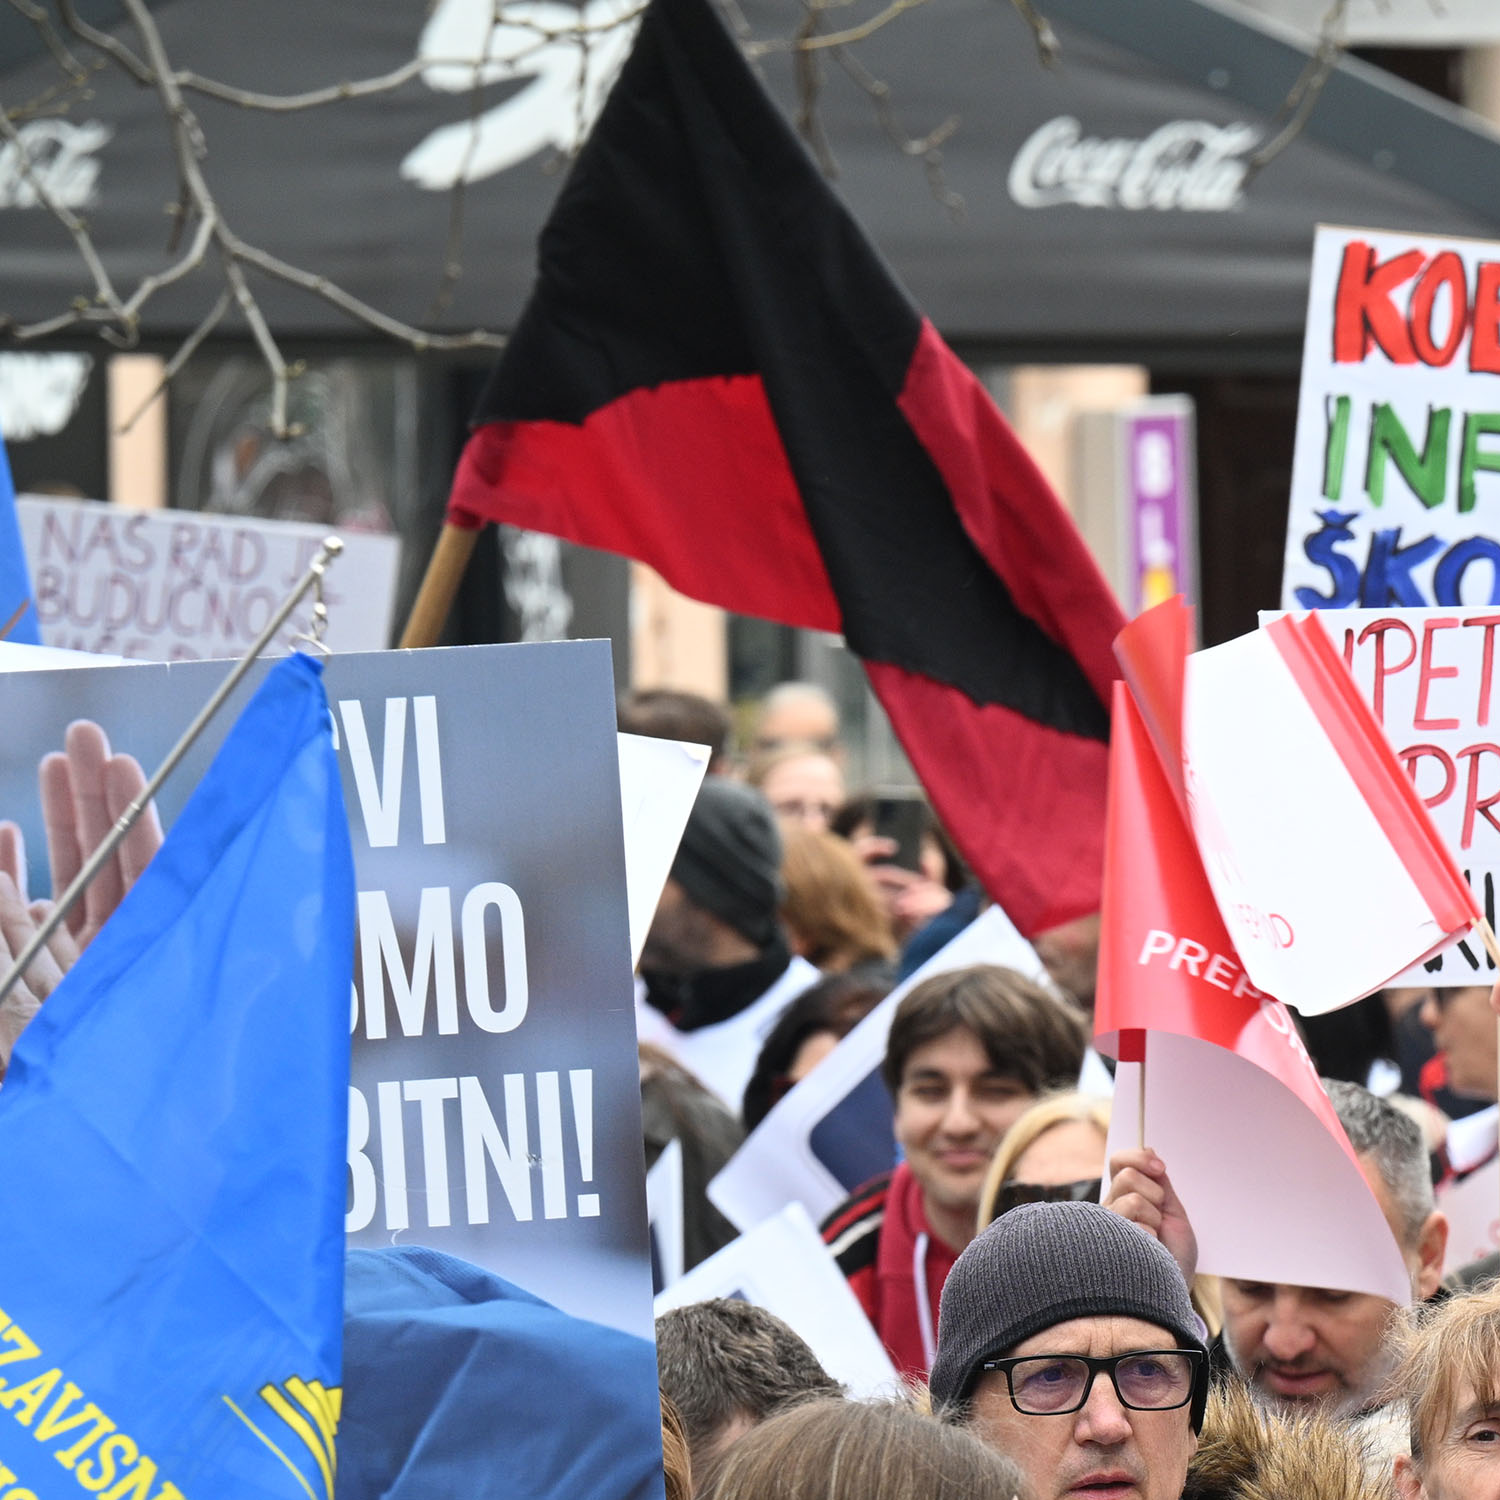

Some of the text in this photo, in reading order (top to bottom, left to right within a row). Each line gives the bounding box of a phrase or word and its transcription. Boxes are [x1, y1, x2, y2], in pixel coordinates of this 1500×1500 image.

[1008, 116, 1262, 212] Coca-Cola
[330, 695, 446, 848] VI
[348, 882, 530, 1040] MO
